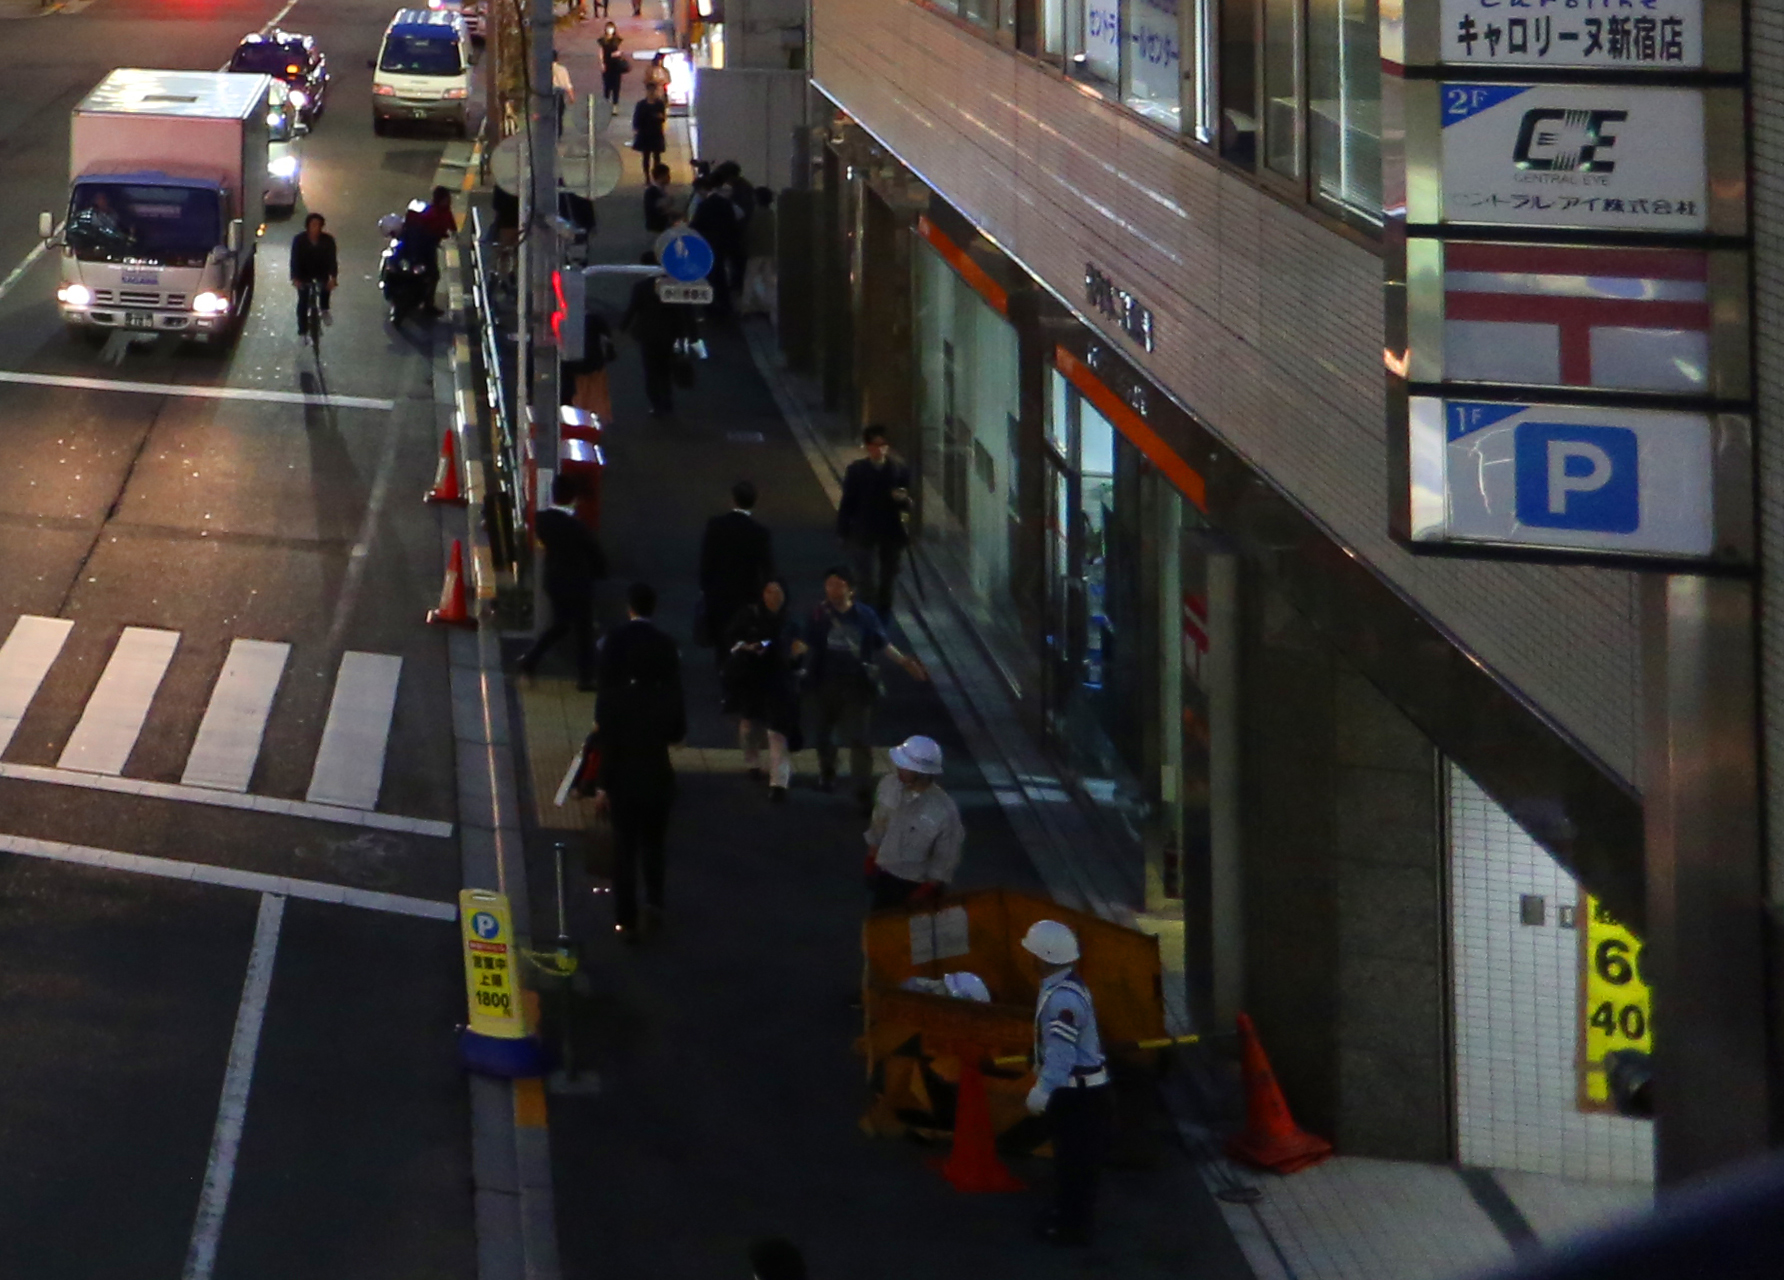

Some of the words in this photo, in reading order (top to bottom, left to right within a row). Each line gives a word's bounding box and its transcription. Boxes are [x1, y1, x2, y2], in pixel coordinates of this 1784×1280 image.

[1457, 13, 1683, 61] キャロリーヌ新宿店
[1447, 88, 1486, 115] 2F
[1455, 406, 1481, 432] 1F
[1547, 439, 1612, 514] P
[476, 915, 495, 937] P
